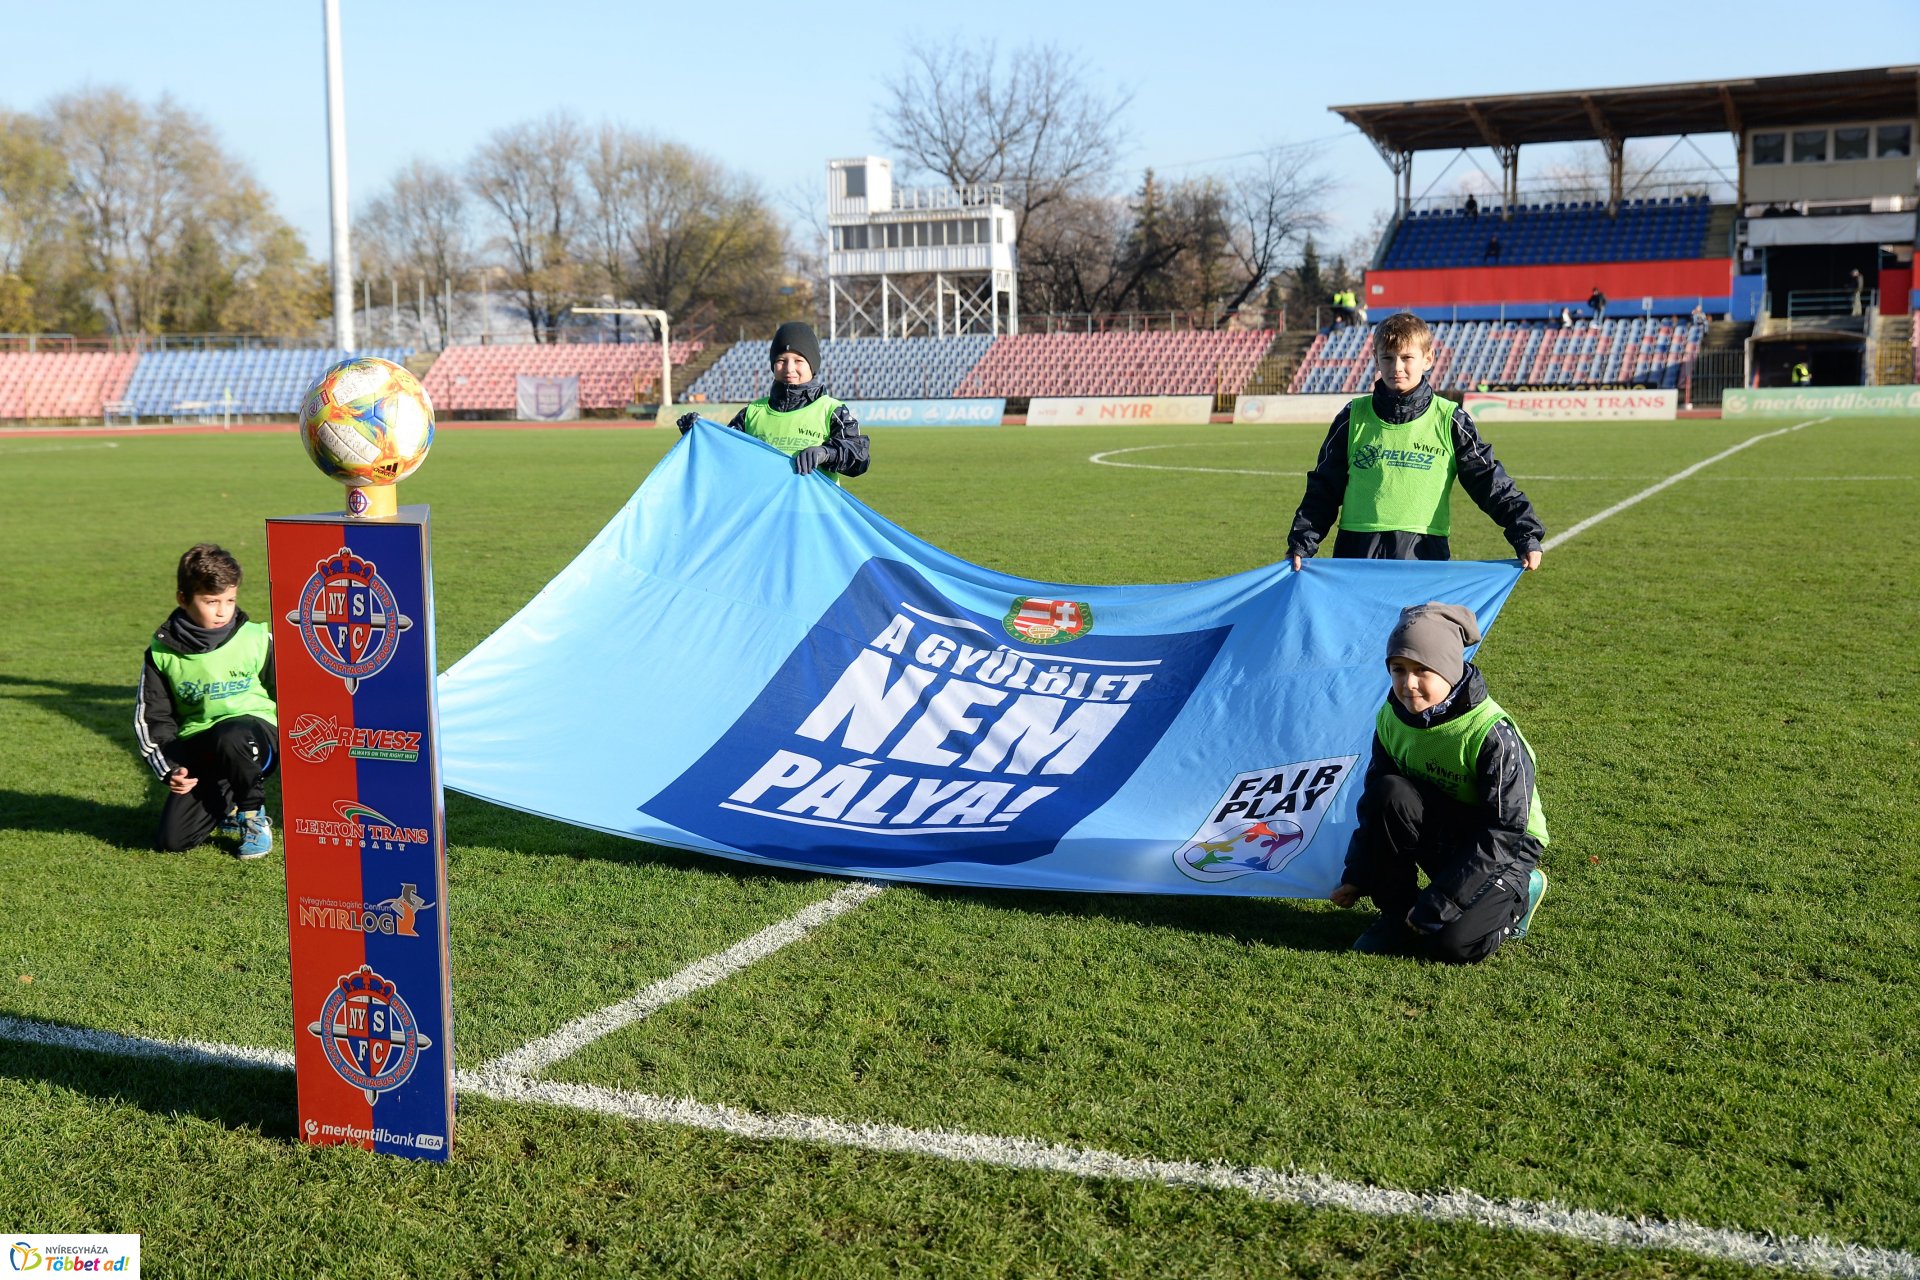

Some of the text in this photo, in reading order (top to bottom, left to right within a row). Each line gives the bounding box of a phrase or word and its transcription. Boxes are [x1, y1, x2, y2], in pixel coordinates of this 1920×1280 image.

[1506, 396, 1665, 410] LERTON TRANS
[1752, 391, 1905, 410] merkantilbank
[865, 406, 913, 421] JAKO
[945, 405, 994, 420] JAKO
[1380, 449, 1435, 464] REVESZ
[869, 613, 915, 655] A
[203, 677, 252, 694] REVESZ
[794, 648, 1131, 776] NEM
[338, 727, 422, 751] REVESZ
[728, 749, 1060, 827] PÁLYA!
[1230, 765, 1343, 801] FAIR
[1213, 786, 1332, 823] PLAY
[296, 819, 429, 844] LERTON TRANS
[339, 901, 362, 909] Logistic
[363, 902, 392, 913] Centrum
[299, 904, 394, 935] NYIRLOG
[321, 1124, 441, 1147] merkantilbank LIGA
